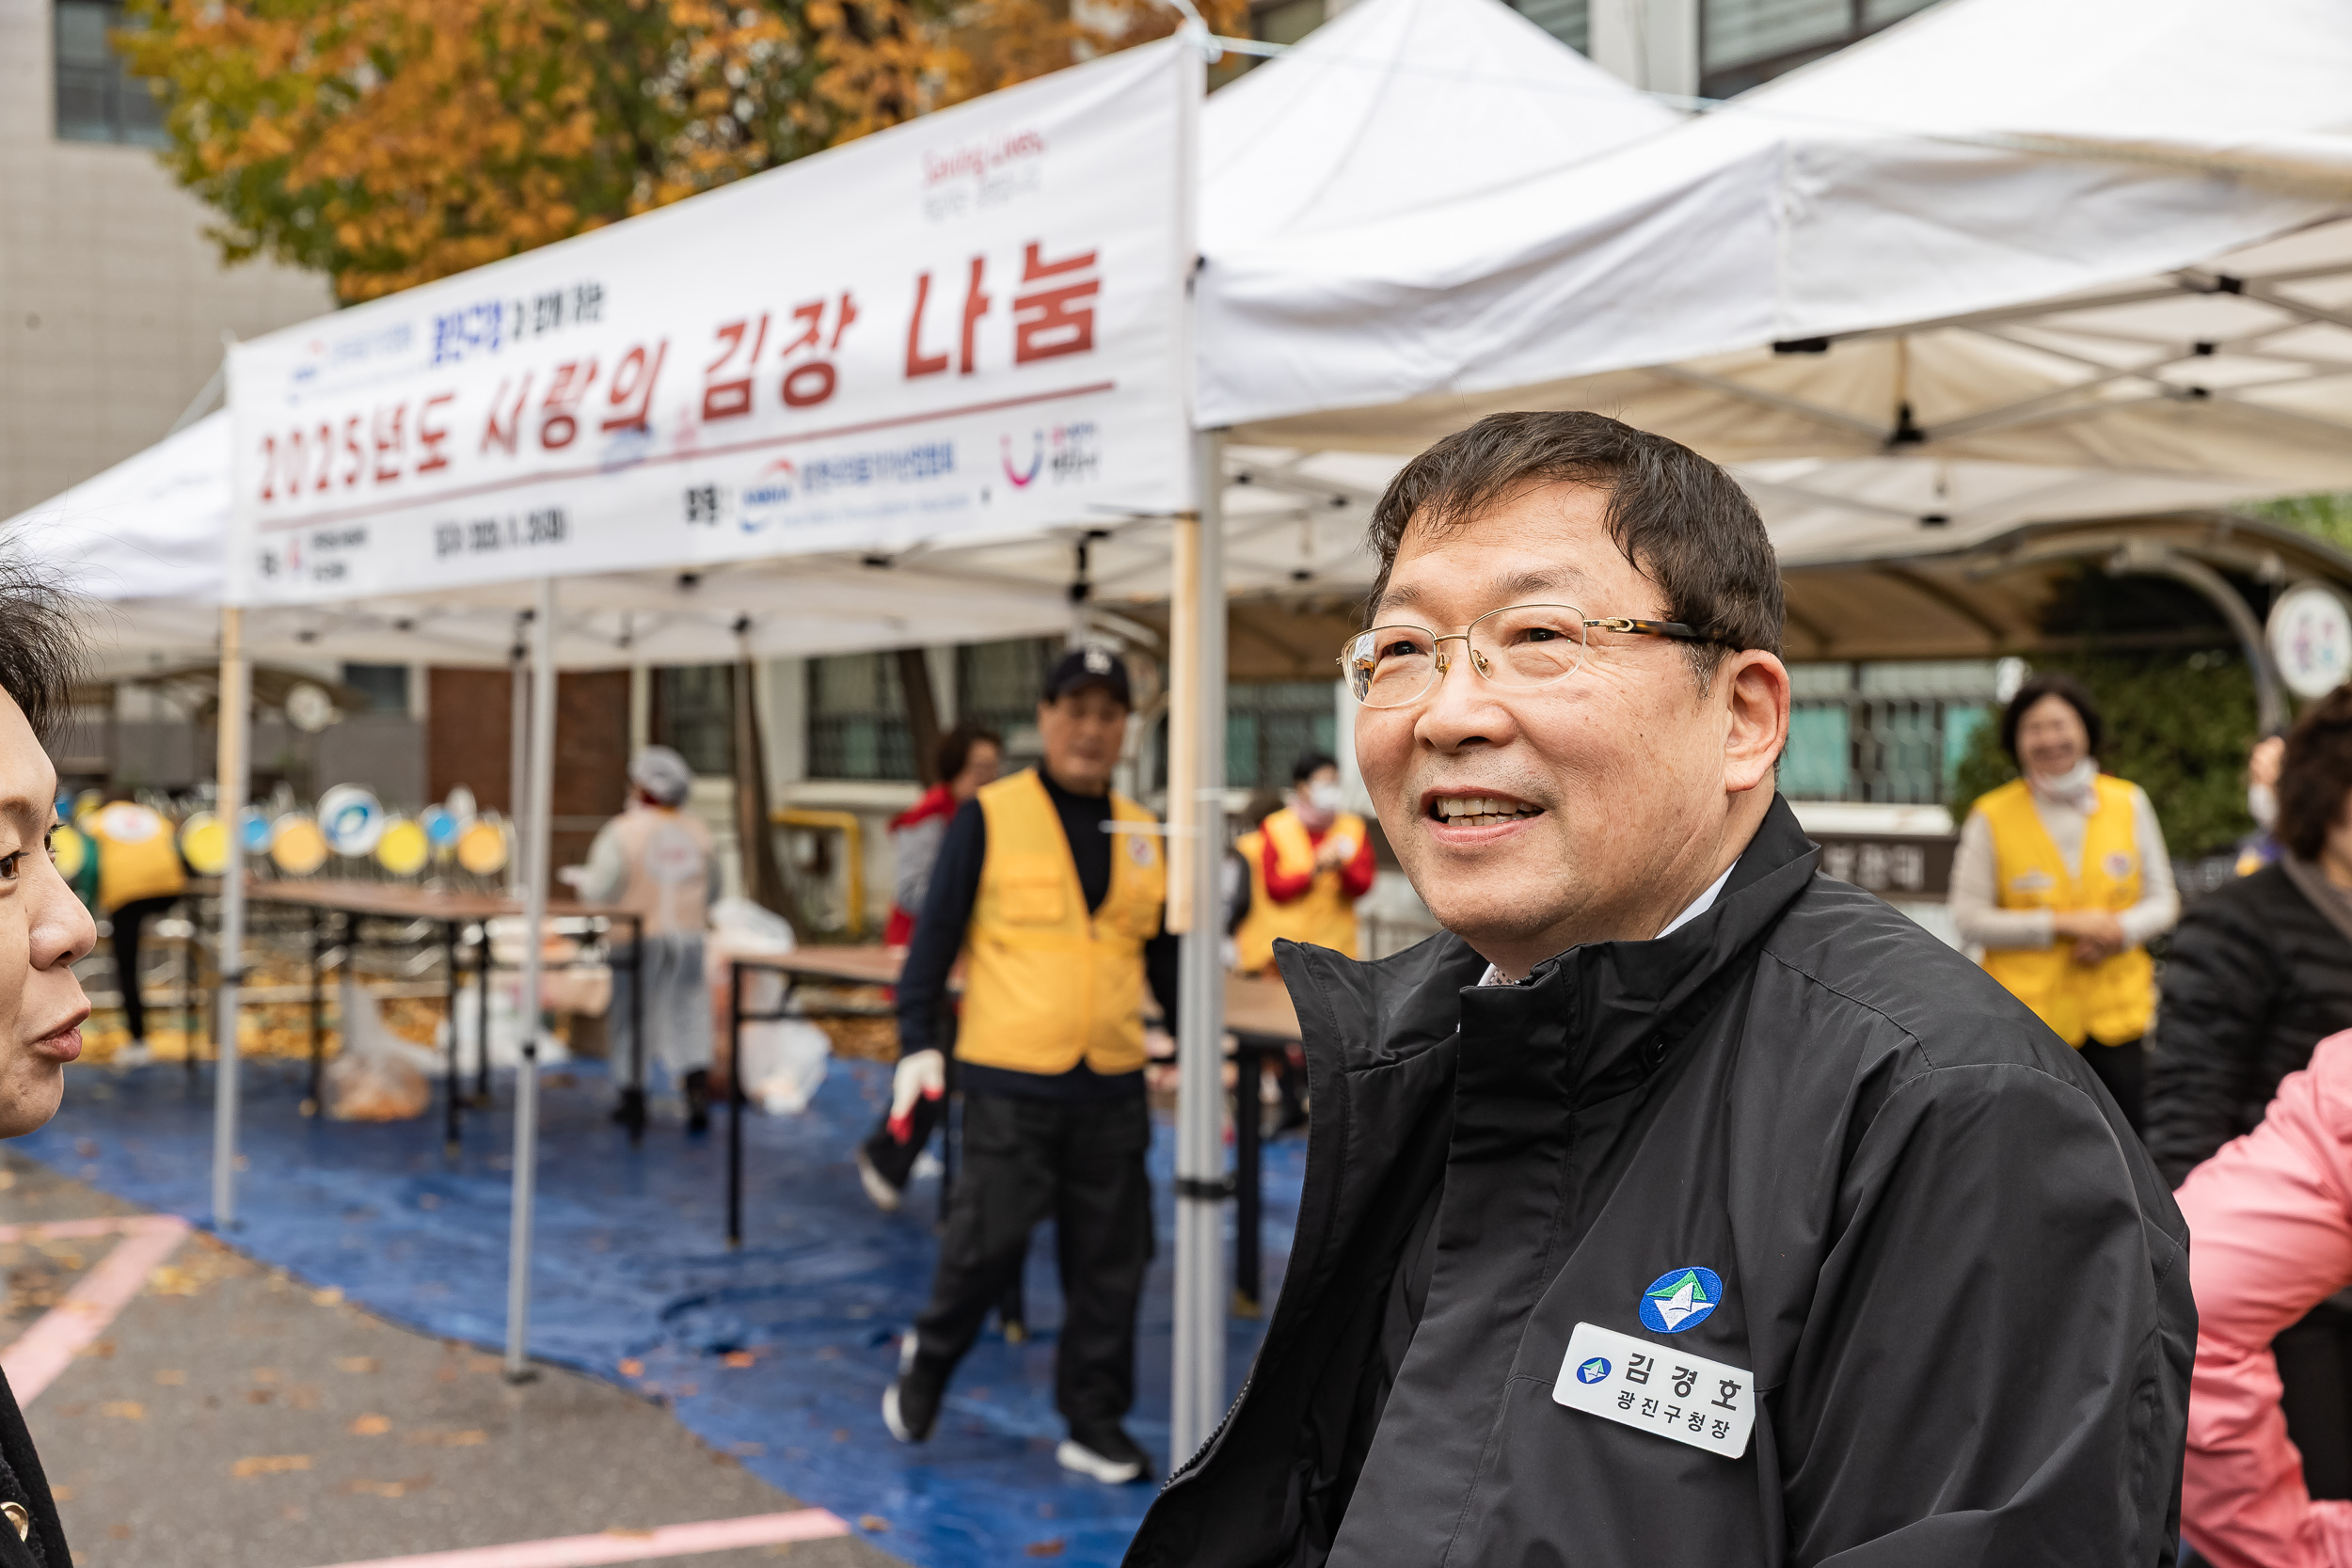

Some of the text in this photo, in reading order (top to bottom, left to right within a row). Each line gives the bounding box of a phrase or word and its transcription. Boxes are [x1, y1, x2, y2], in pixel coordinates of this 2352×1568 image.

[258, 389, 455, 503] 2025년도
[479, 340, 668, 453] 사랑의
[699, 291, 860, 423] 김장
[902, 241, 1103, 382] 나눔
[1617, 1390, 1730, 1439] 광진구청장
